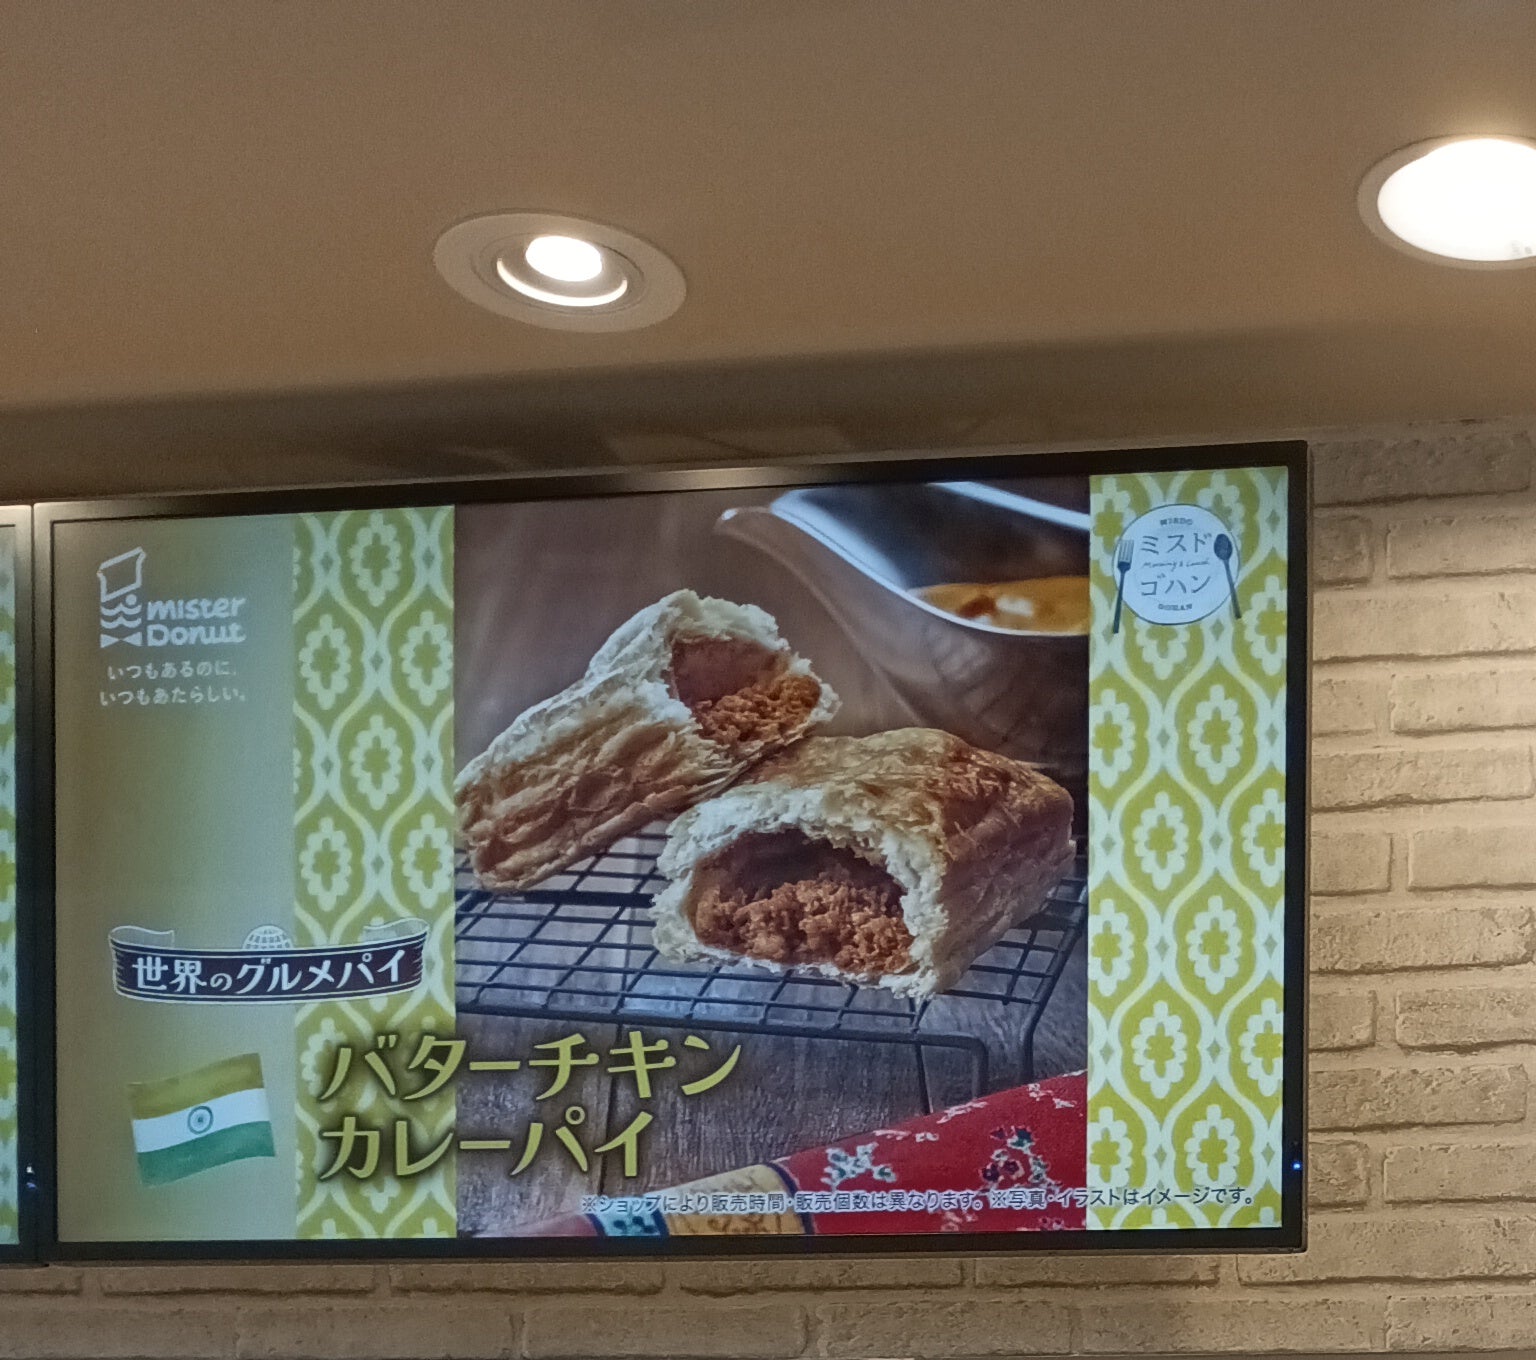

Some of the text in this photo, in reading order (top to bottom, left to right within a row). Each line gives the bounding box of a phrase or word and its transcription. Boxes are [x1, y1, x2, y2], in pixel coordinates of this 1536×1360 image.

[1141, 533, 1212, 554] ミスド
[1141, 574, 1211, 596] ゴハン
[147, 623, 247, 647] Donut
[99, 685, 247, 706] いつもあたらしい。
[132, 948, 409, 997] 世界のグルメパイ
[316, 1029, 742, 1102] バターチキン
[320, 1105, 657, 1181] カレーパイ
